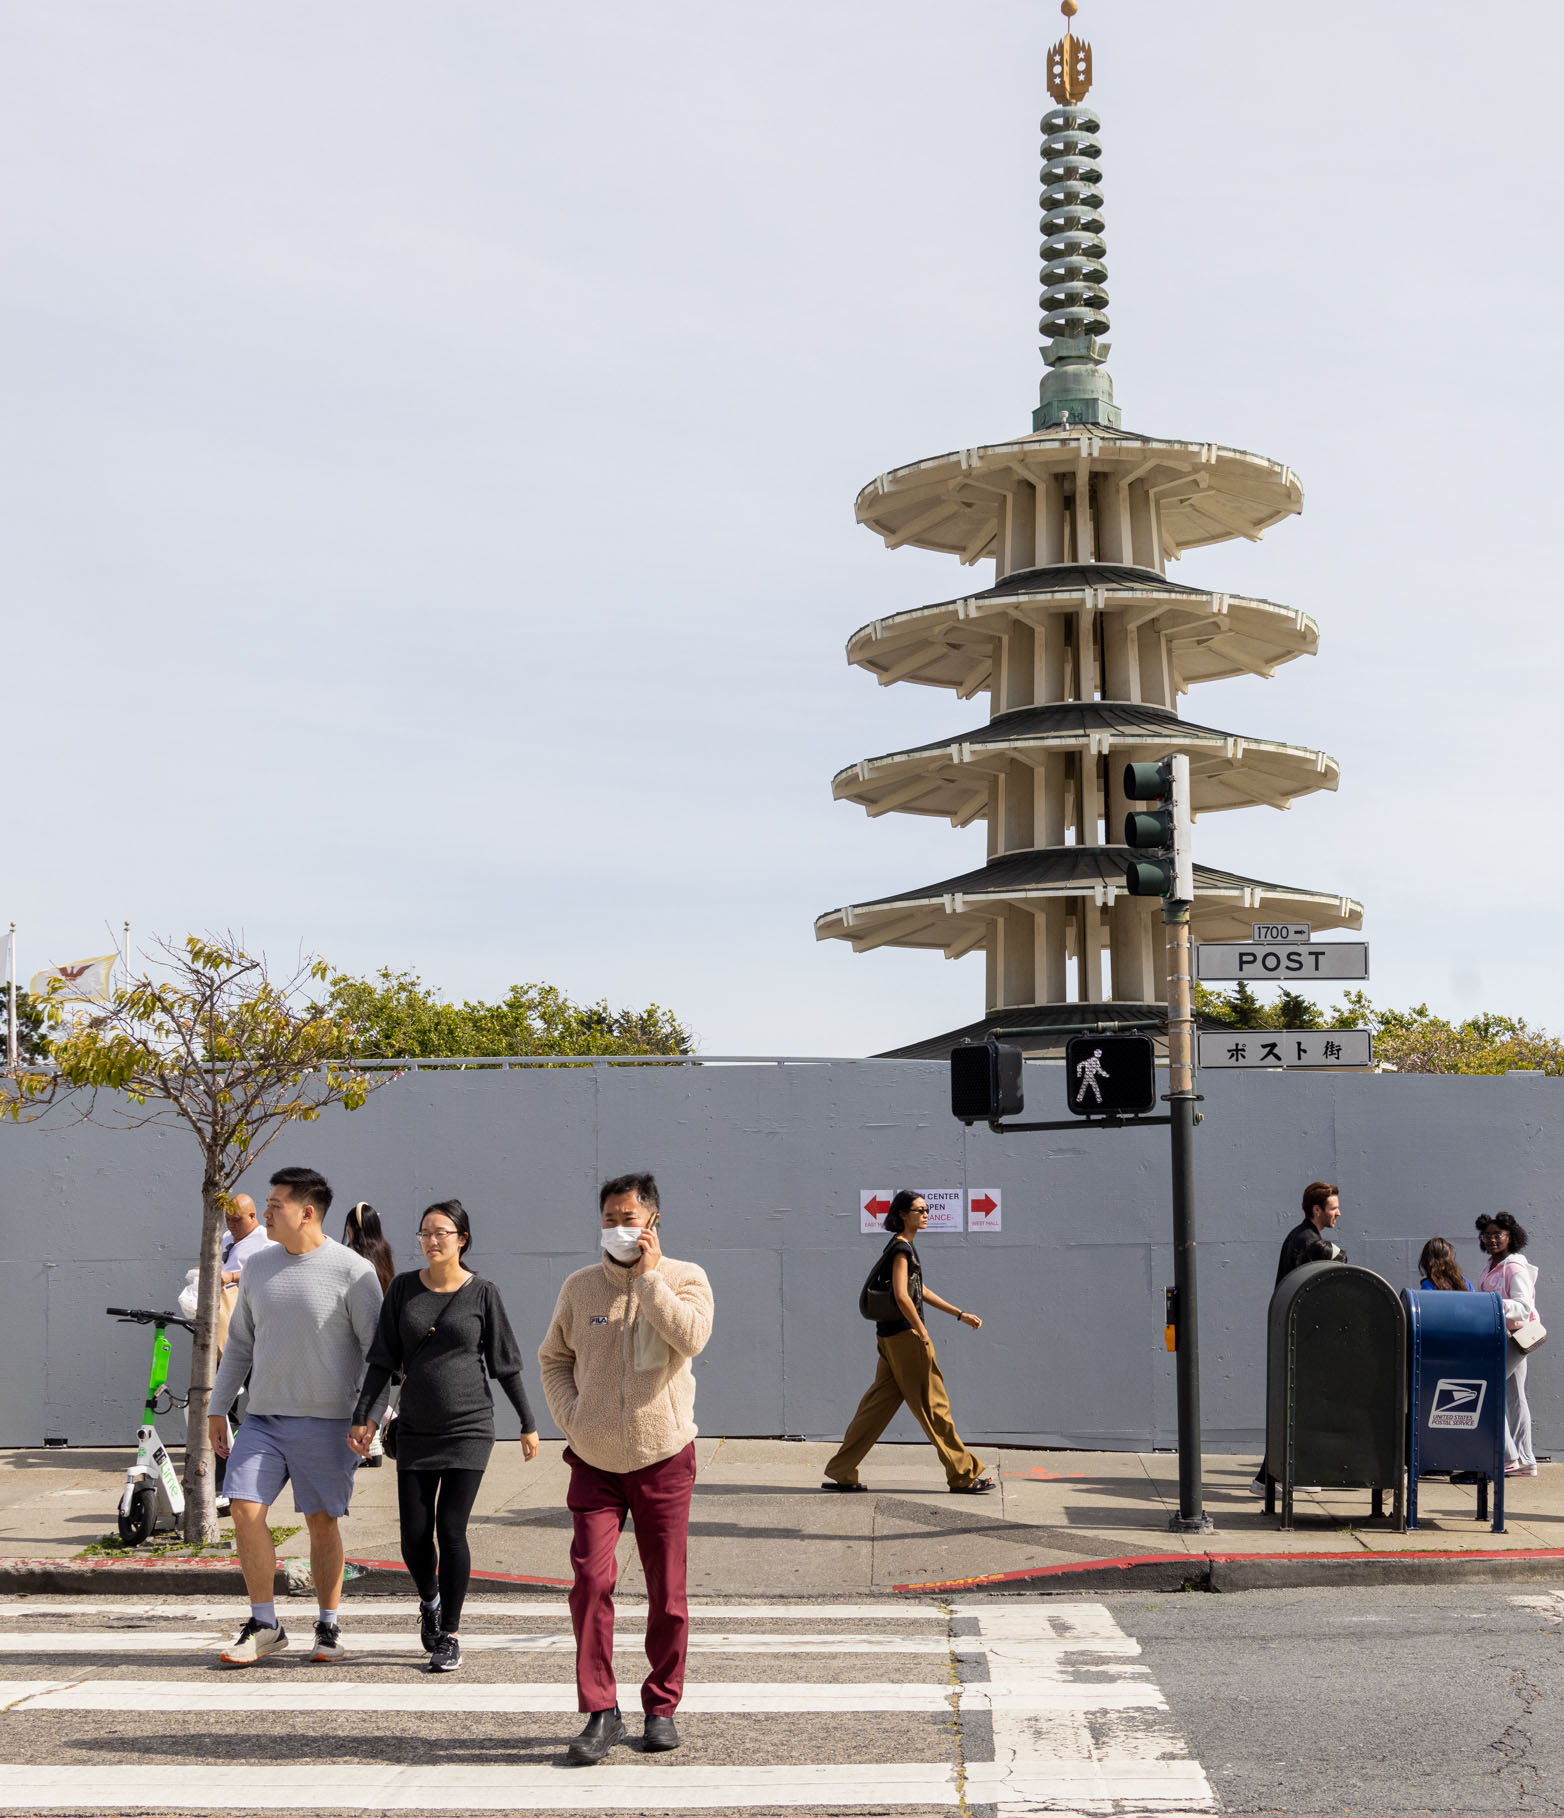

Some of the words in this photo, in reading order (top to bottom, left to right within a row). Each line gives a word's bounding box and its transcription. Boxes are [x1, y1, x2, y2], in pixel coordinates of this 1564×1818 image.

[1257, 926, 1289, 940] 1700
[1238, 951, 1326, 972] POST
[1226, 1040, 1343, 1062] ポスト街
[160, 1460, 178, 1496] Lime
